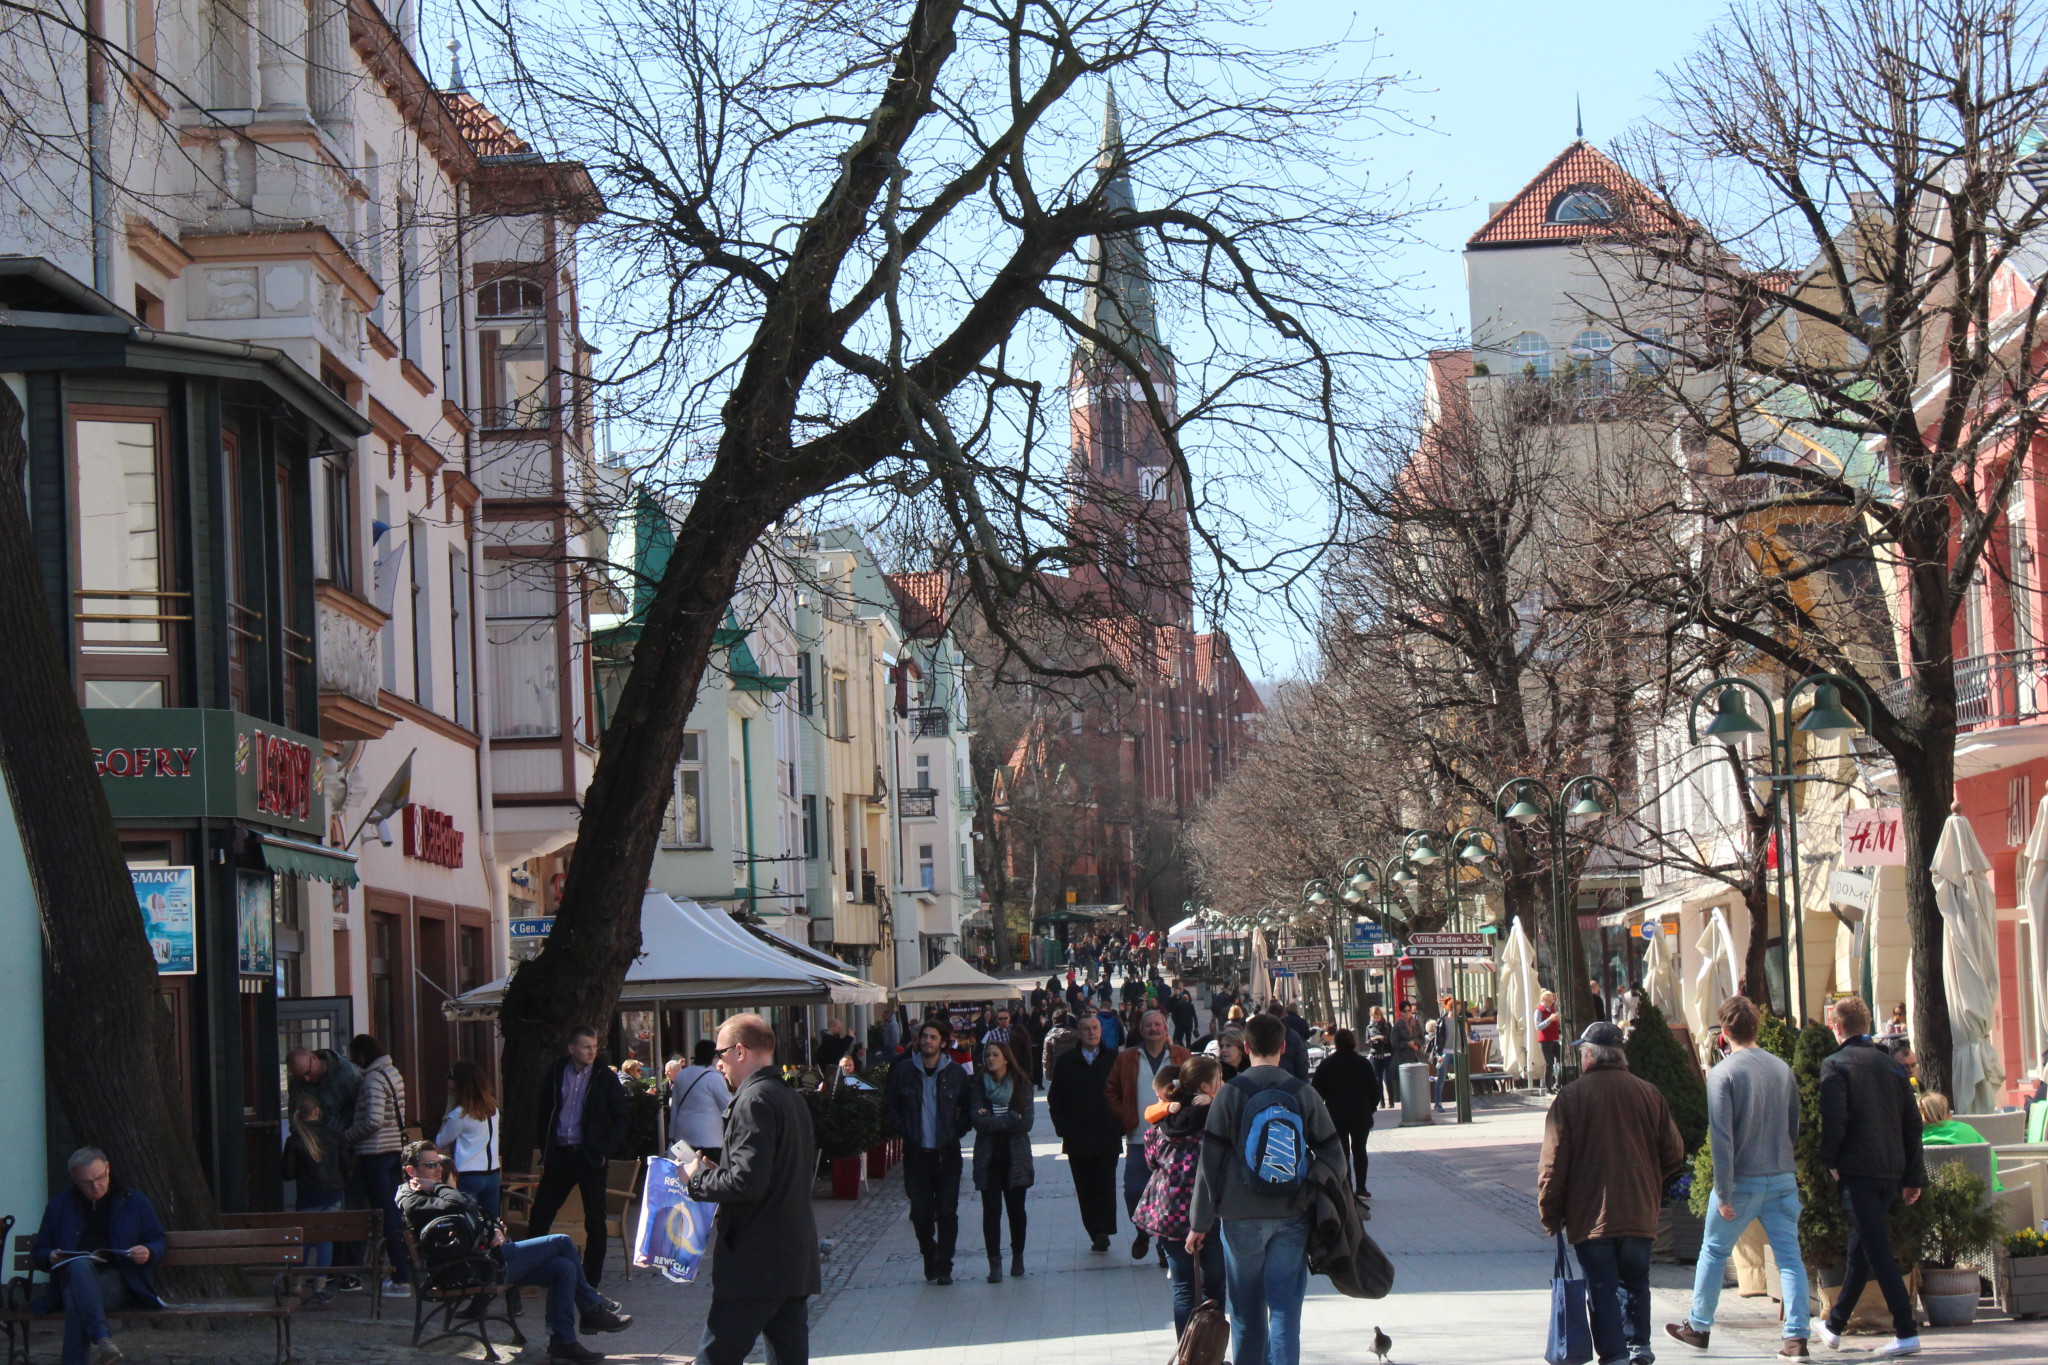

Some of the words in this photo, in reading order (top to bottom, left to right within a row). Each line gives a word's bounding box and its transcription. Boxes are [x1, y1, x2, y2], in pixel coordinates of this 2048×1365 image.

[1849, 820, 1897, 853] H&M
[131, 871, 178, 884] SMAKI
[519, 923, 539, 933] Gen.
[1416, 935, 1434, 943] Villa
[1436, 935, 1461, 943] Sedan
[1428, 948, 1449, 956] Tapas
